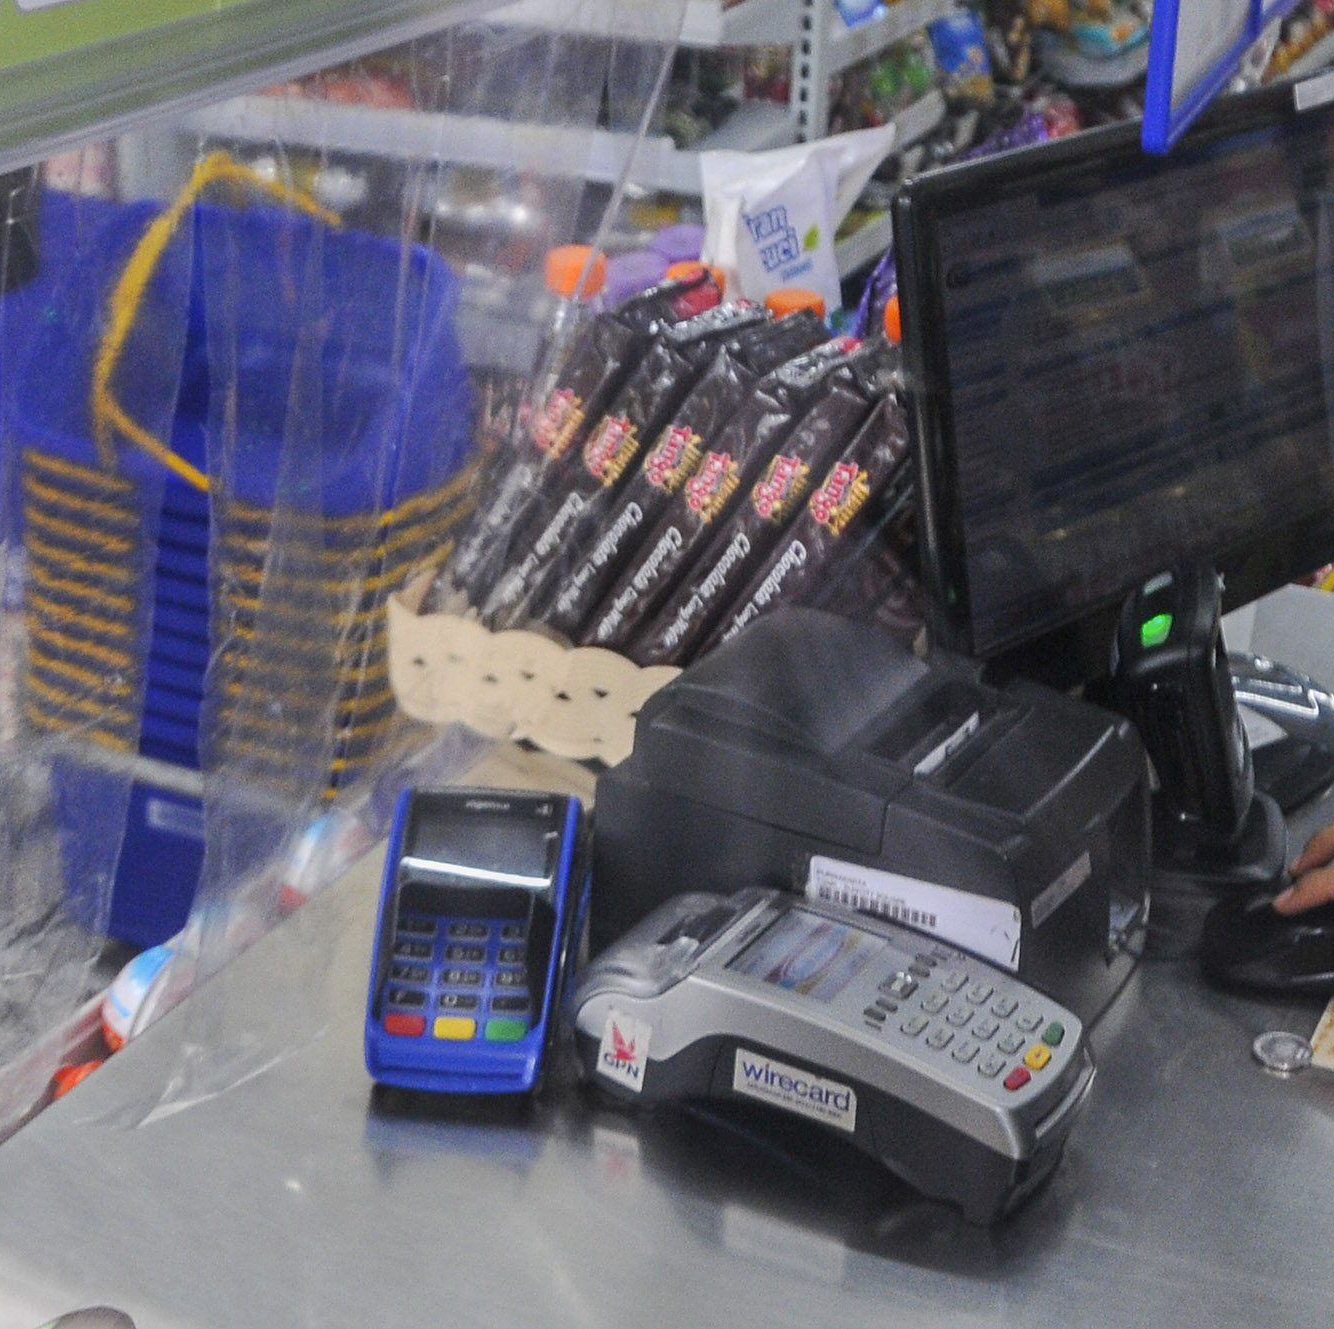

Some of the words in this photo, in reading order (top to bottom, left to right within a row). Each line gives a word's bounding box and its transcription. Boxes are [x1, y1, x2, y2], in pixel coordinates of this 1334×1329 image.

[647, 427, 692, 486] Tango
[686, 452, 730, 511] Tango
[754, 456, 801, 519] Tango
[809, 462, 859, 524] Tango
[592, 502, 643, 566] Chocolate
[633, 526, 683, 590] Chocolate
[699, 532, 751, 598] Chocolate
[754, 540, 807, 606] Chocolate
[603, 1052, 639, 1079] GPN
[742, 1060, 851, 1113] wirecard
